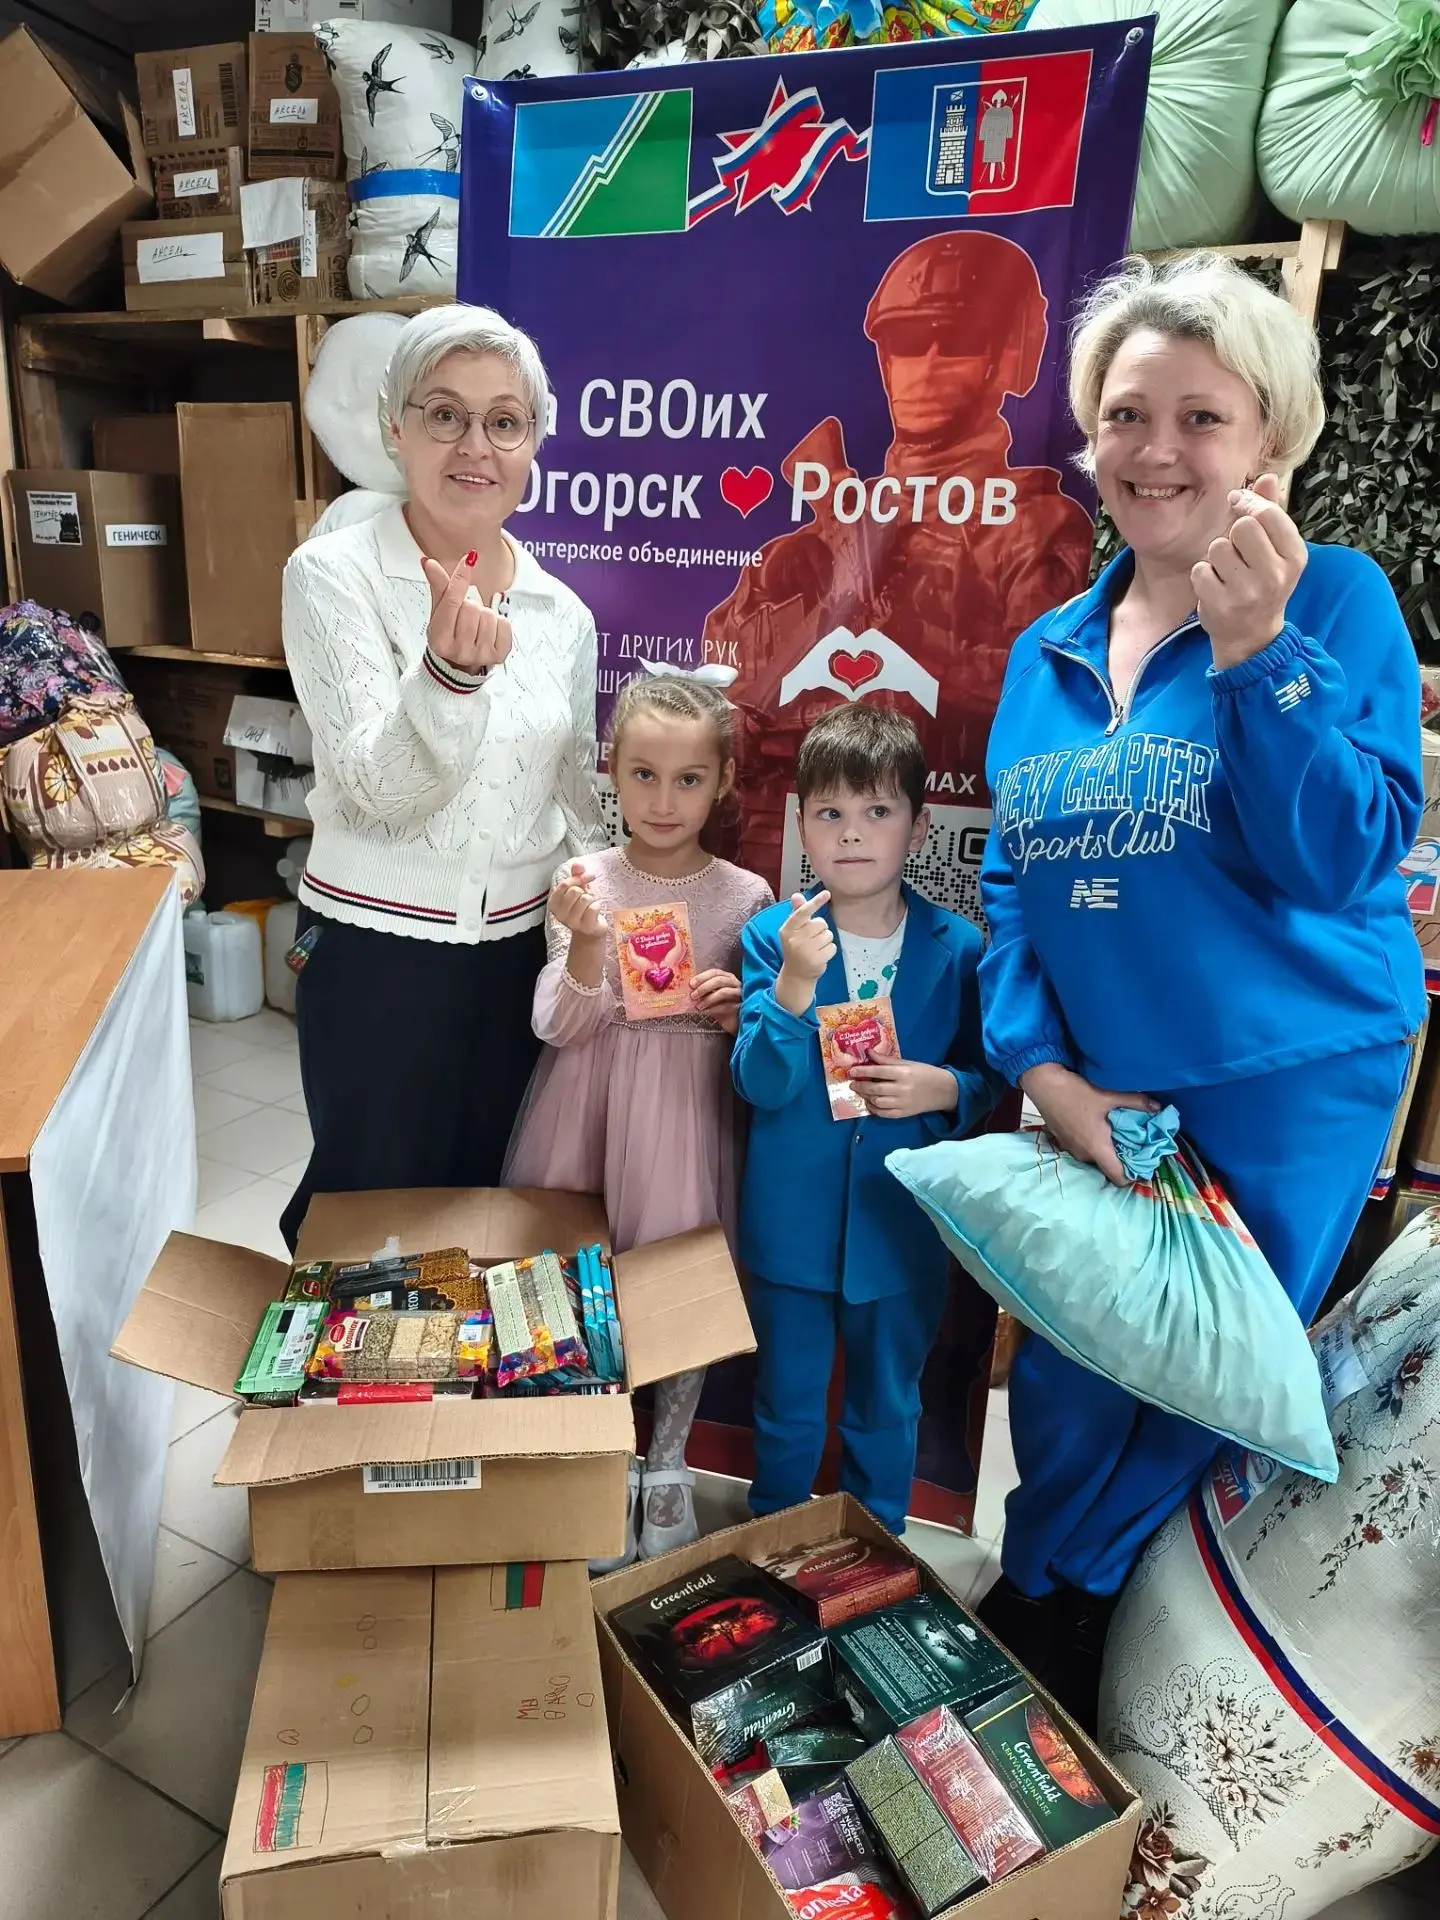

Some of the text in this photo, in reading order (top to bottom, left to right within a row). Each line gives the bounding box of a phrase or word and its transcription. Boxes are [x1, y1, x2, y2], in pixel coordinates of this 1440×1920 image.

[580, 378, 768, 439] СВОих
[791, 461, 1017, 525] Ростов
[113, 530, 161, 542] ГЕНИЧЕСК
[628, 541, 763, 568] объединение
[618, 634, 694, 663] ДРУГИХ
[704, 640, 742, 669] РУК,
[996, 733, 1216, 836] NEW CHAPTER
[649, 1574, 716, 1611] Greenfield
[743, 1701, 796, 1742] Greenfield
[1000, 1741, 1053, 1817] KENYAN SUNRISE
[1014, 1741, 1062, 1803] Greenfield
[839, 1819, 854, 1844] TASTE
[844, 1815, 865, 1855] NUANCED
